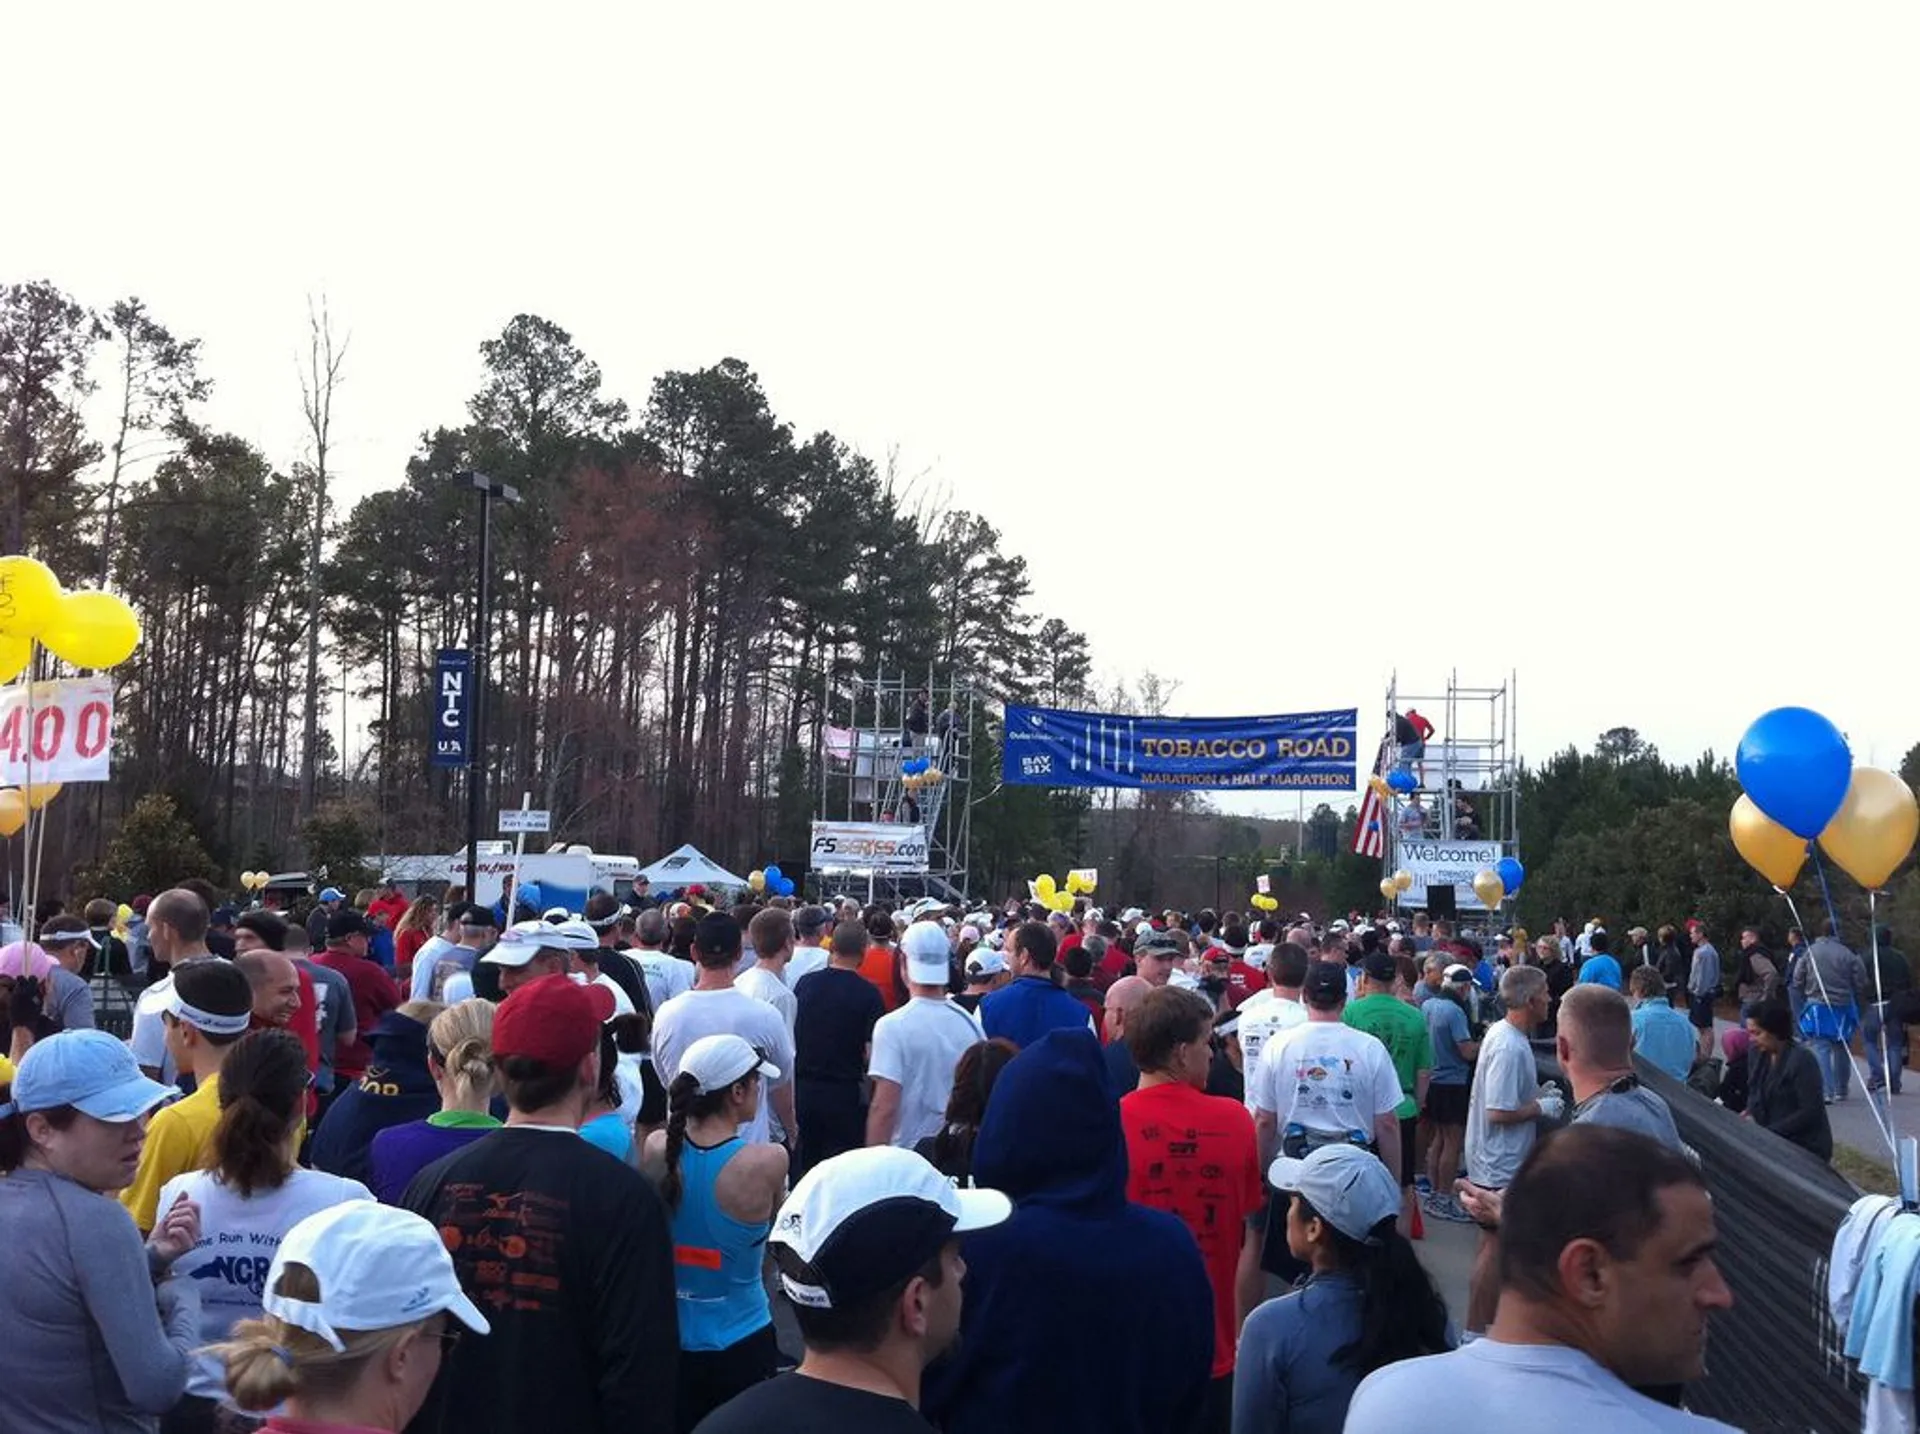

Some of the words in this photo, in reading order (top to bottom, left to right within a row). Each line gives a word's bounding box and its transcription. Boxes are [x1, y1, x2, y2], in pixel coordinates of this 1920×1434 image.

[442, 671, 462, 727] NTC
[1141, 738, 1266, 759] TOBACCO
[1277, 737, 1351, 758] ROAD
[1022, 755, 1051, 766] BAY
[1023, 764, 1052, 776] SIX
[1140, 773, 1216, 785] MARATHON
[1218, 774, 1229, 785] &
[1231, 774, 1269, 785] HALF
[1270, 774, 1351, 785] MARATHON
[1403, 844, 1497, 863] Welcome!
[220, 1231, 243, 1244] Run
